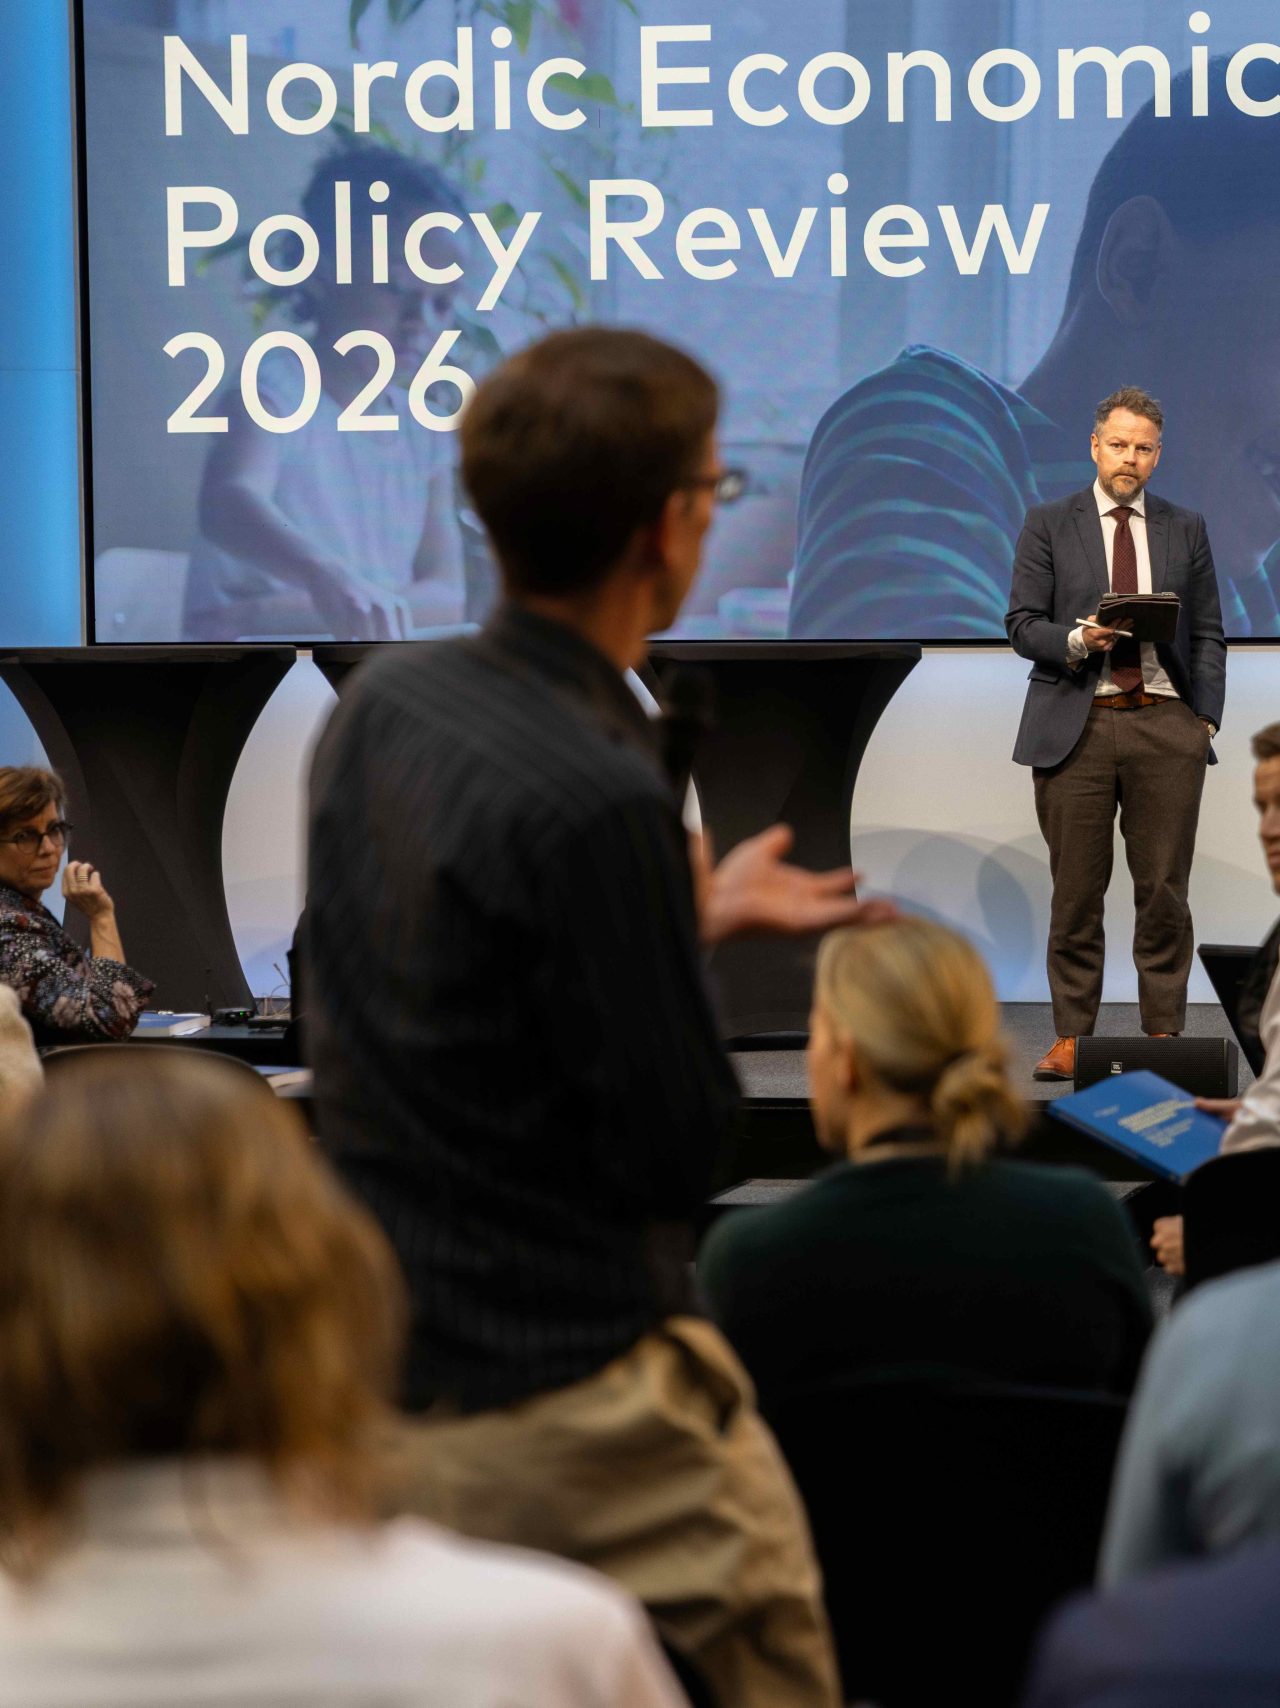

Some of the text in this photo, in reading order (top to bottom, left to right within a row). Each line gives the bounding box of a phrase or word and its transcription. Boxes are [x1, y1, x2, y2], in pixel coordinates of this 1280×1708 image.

[165, 27, 587, 136] Nordic
[165, 172, 1050, 311] Policy Review
[162, 329, 479, 434] 2026
